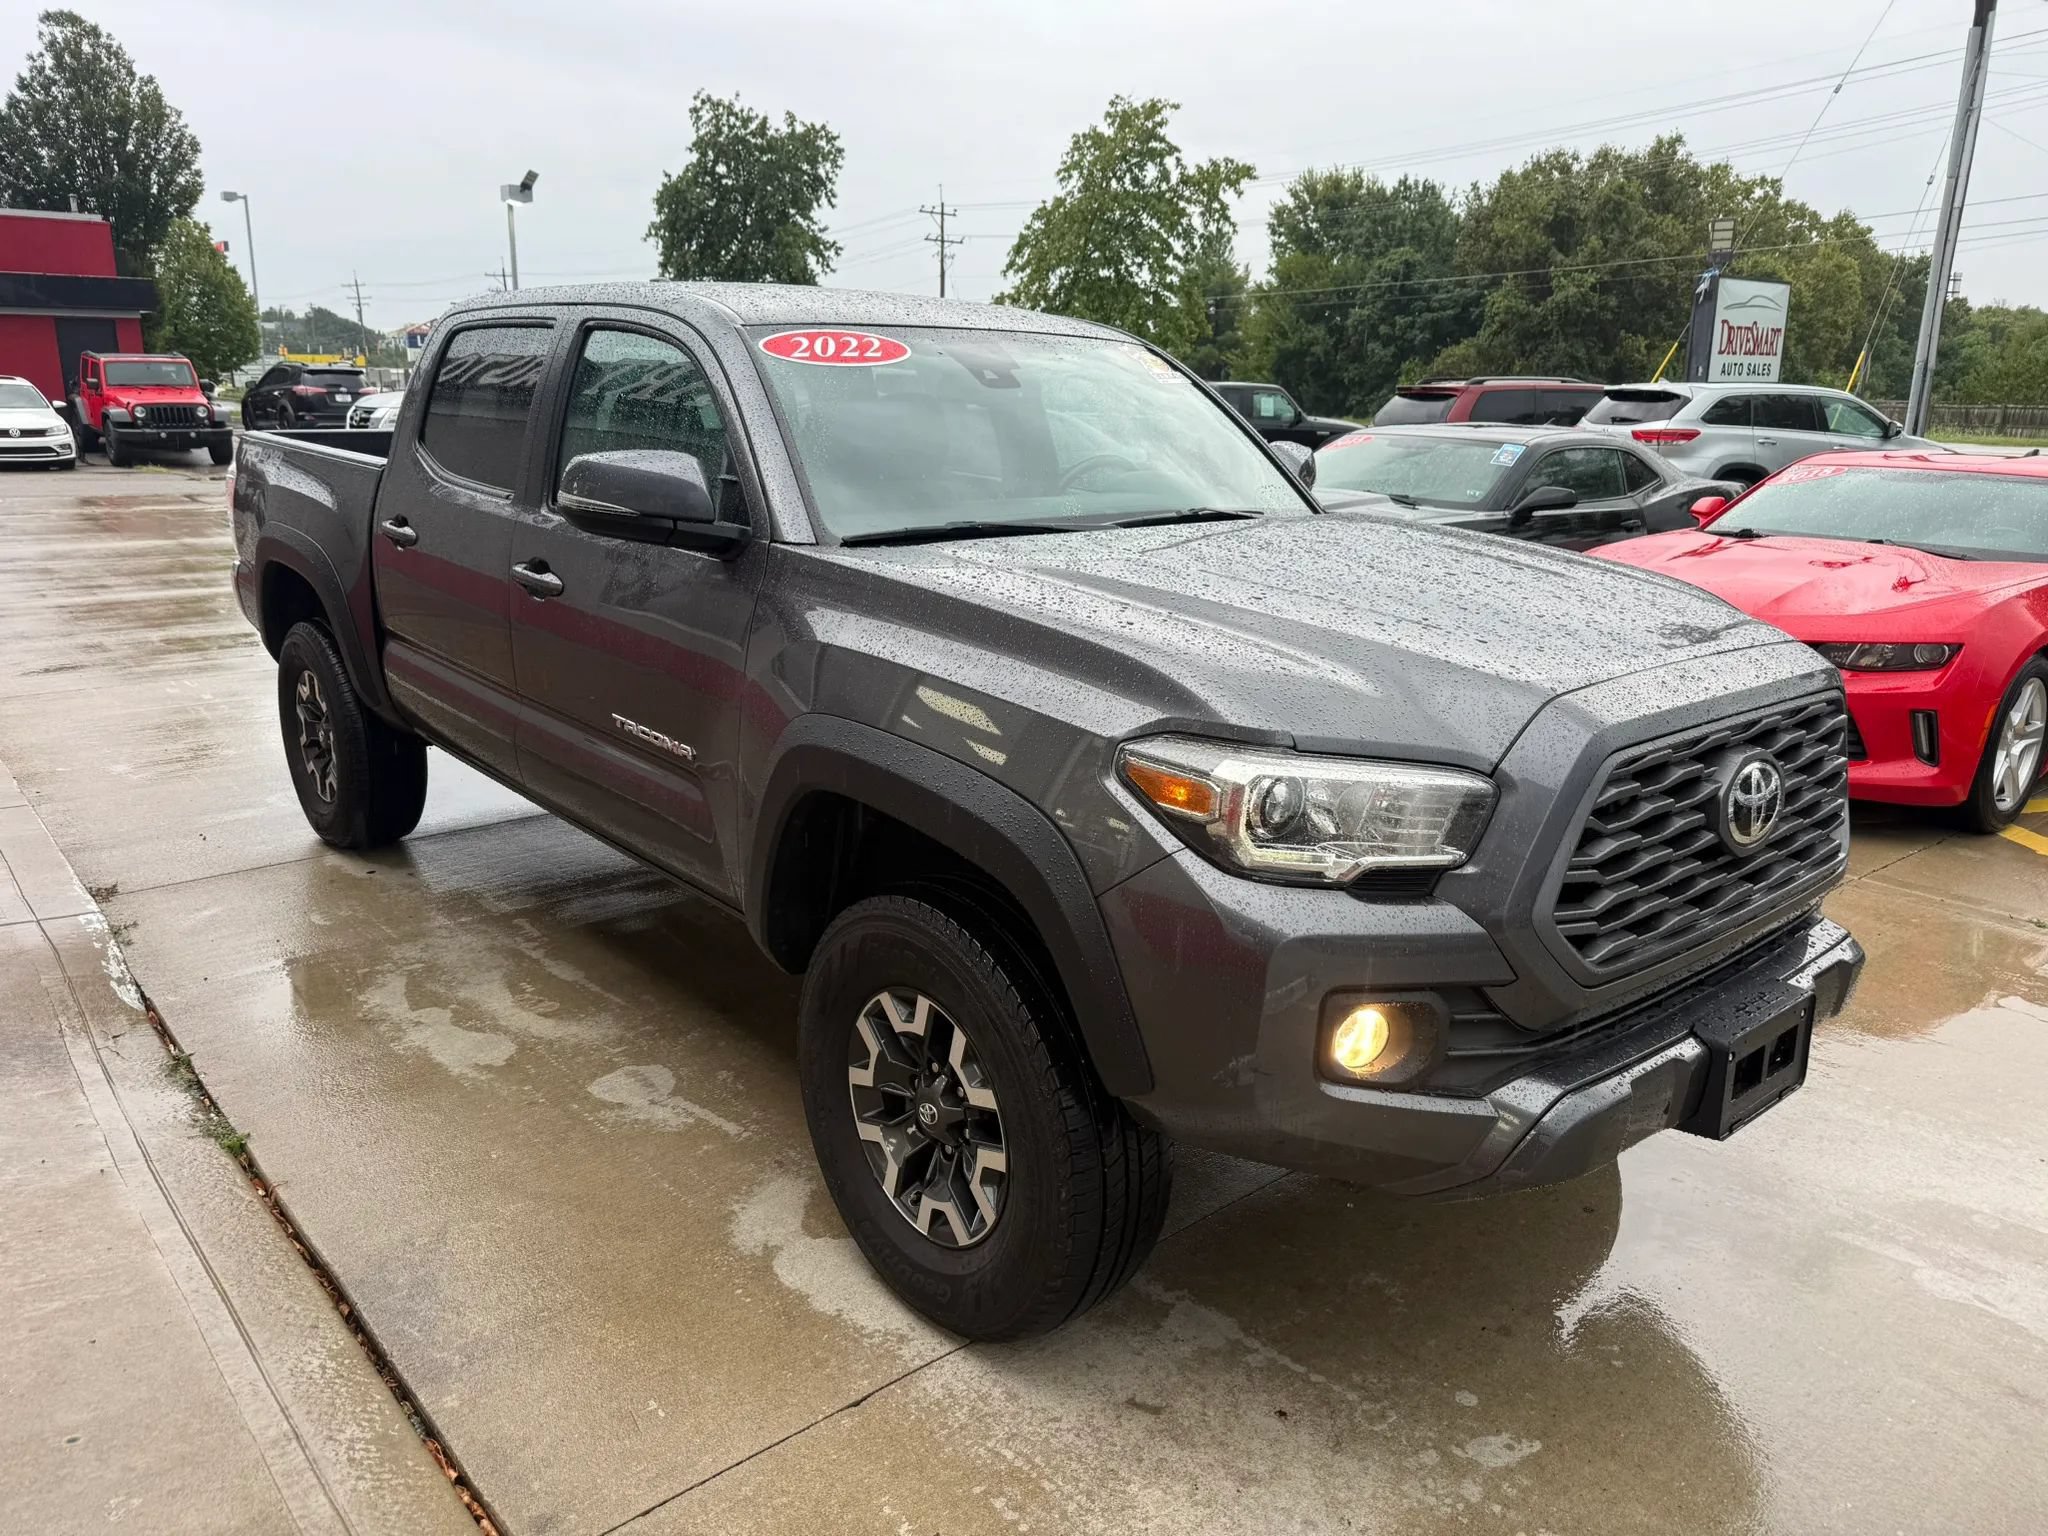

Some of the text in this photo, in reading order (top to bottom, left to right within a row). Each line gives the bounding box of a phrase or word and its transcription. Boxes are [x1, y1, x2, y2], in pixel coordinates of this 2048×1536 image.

[790, 335, 884, 358] 2022
[1720, 362, 1772, 377] AUTO SALES
[611, 712, 697, 761] TACOMA
